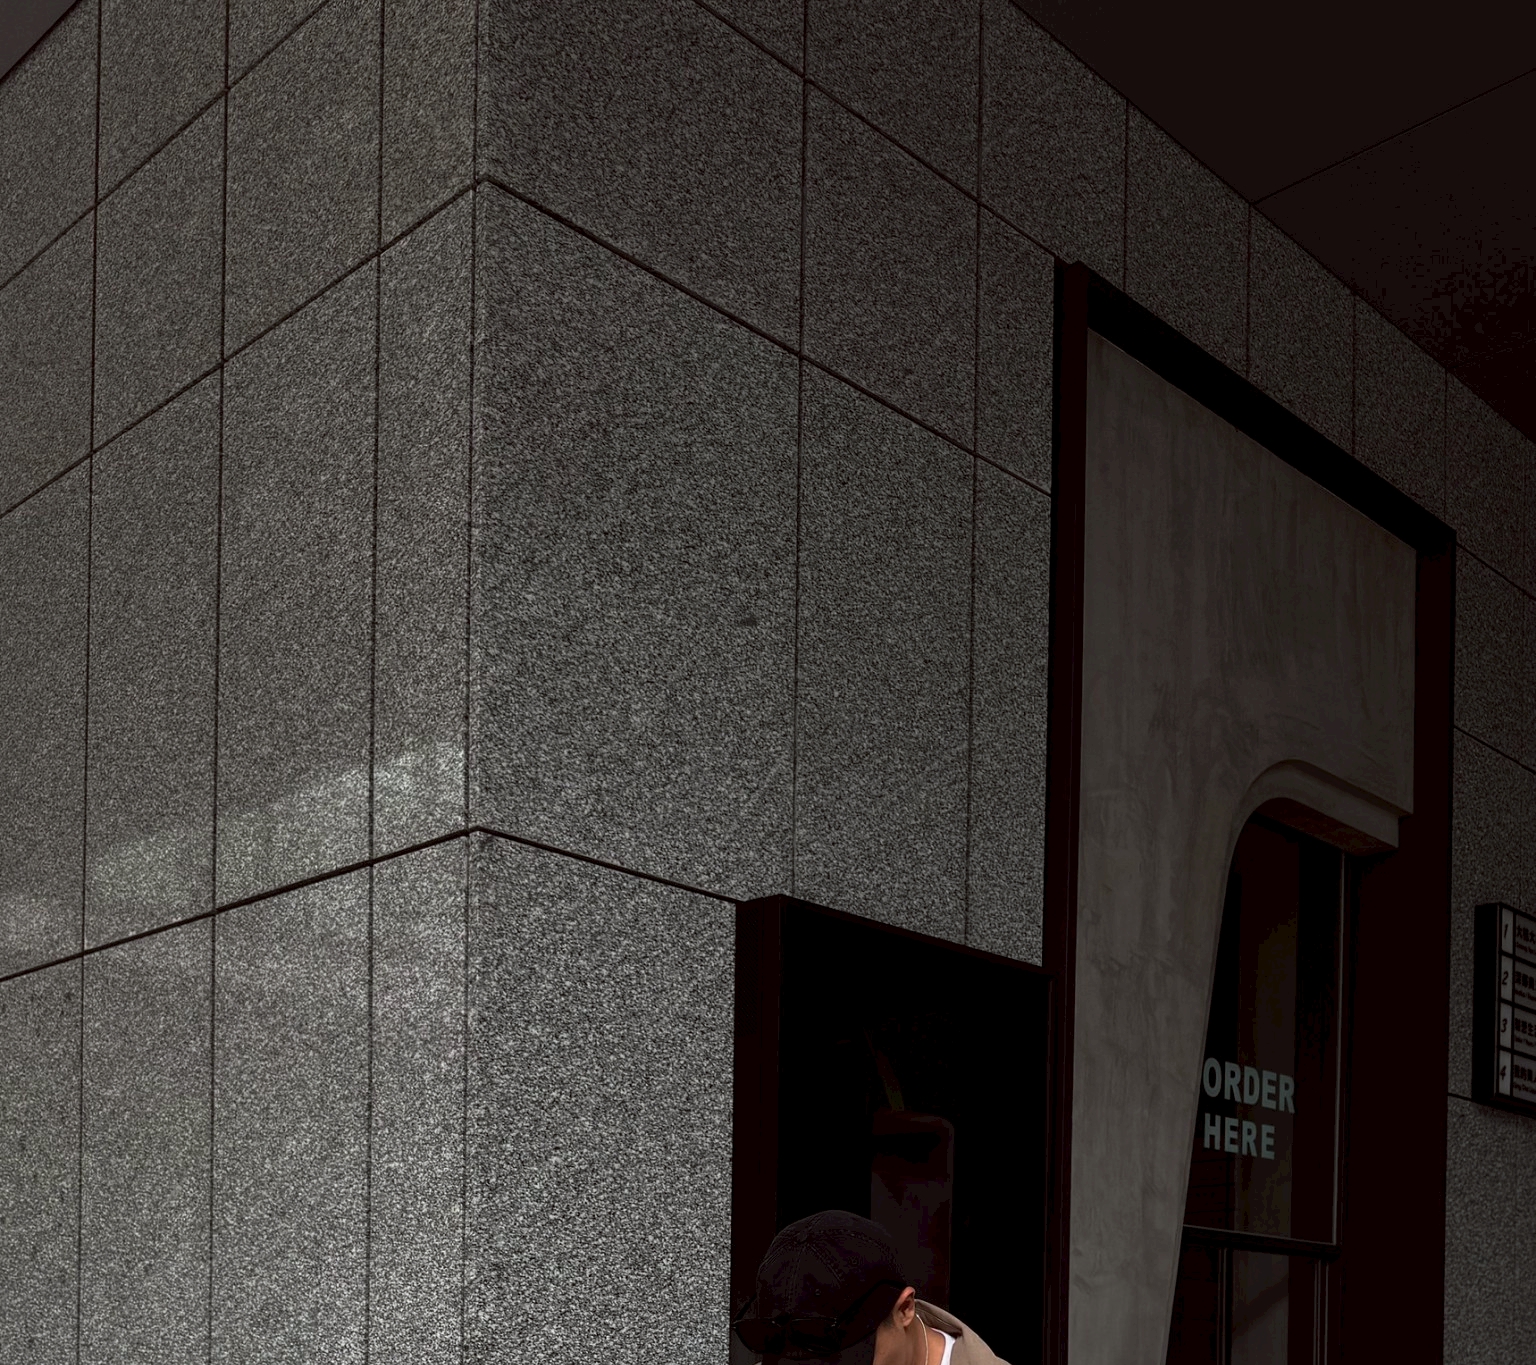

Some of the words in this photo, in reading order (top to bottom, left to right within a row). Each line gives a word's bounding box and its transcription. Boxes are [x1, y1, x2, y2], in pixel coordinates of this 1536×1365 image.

[1503, 923, 1509, 939] 1
[1502, 970, 1509, 985] 2
[1500, 1018, 1508, 1033] 3
[1499, 1065, 1507, 1081] 4
[1203, 1057, 1295, 1113] ORDER
[1203, 1112, 1275, 1160] HERE
